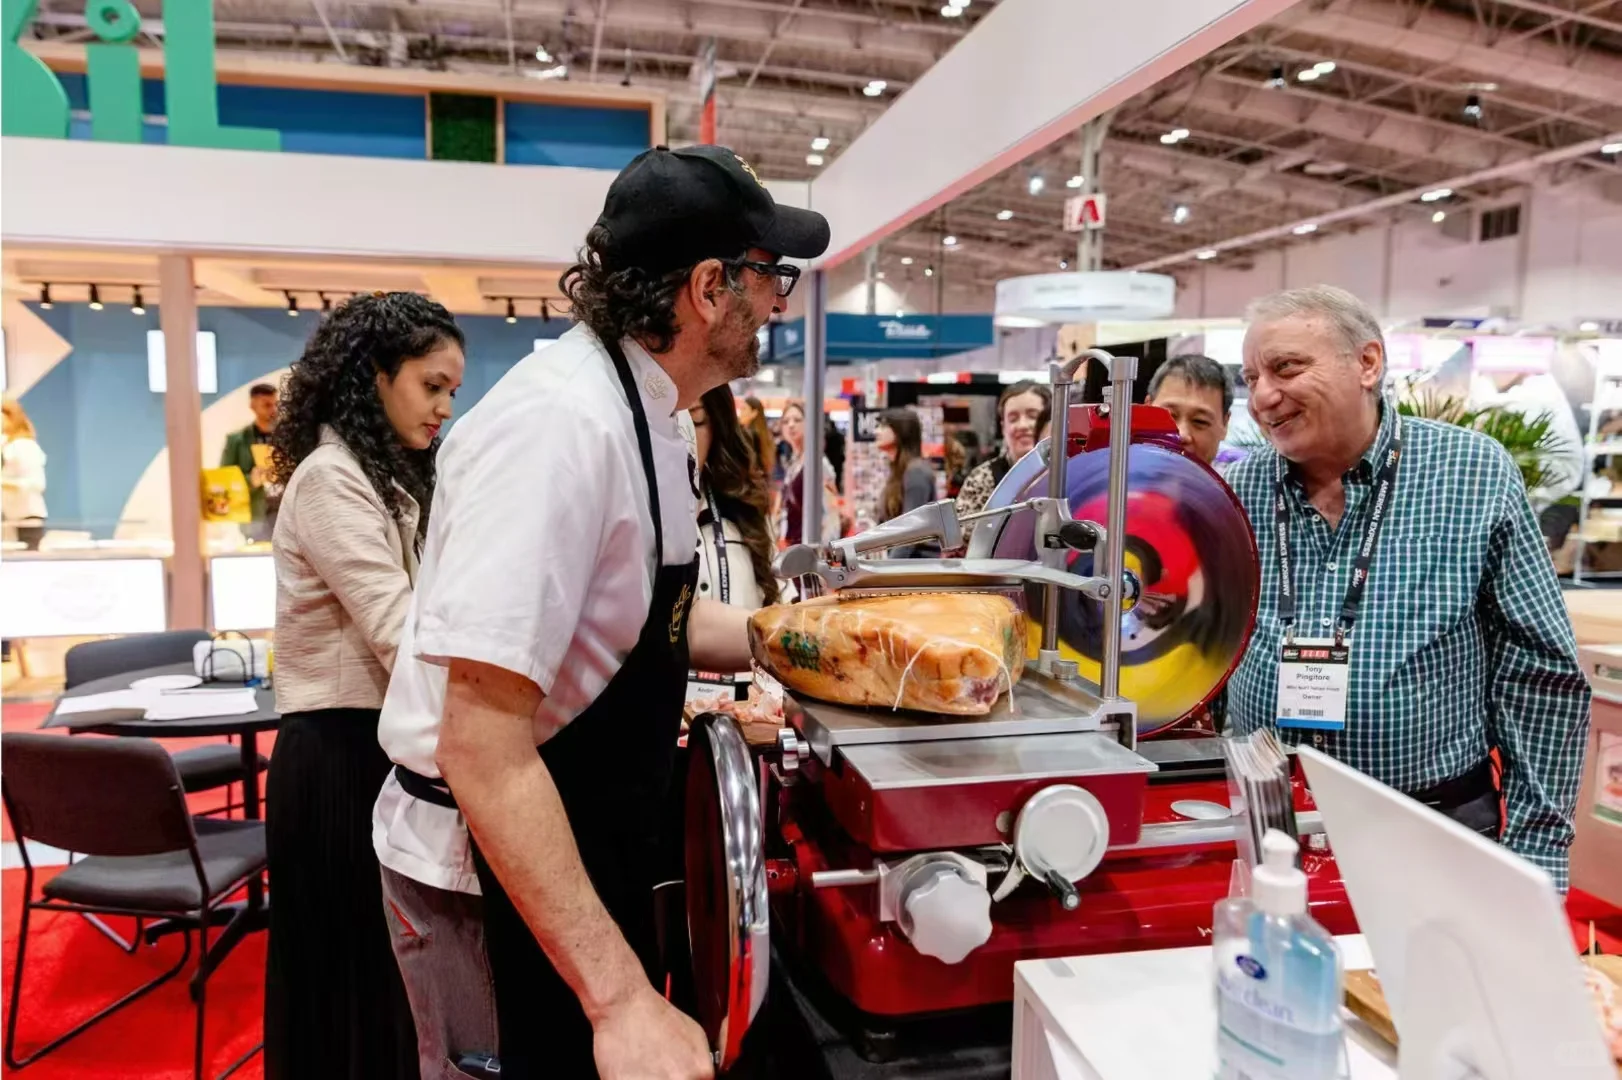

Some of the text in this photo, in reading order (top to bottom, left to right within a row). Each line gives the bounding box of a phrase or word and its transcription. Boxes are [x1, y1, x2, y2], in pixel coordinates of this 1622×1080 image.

[1361, 480, 1389, 558] AMERICAN EXPRESS
[720, 556, 729, 589] EXPRESS
[1279, 522, 1290, 597] AMERICAN EXPRESS
[1305, 665, 1323, 673] Tony
